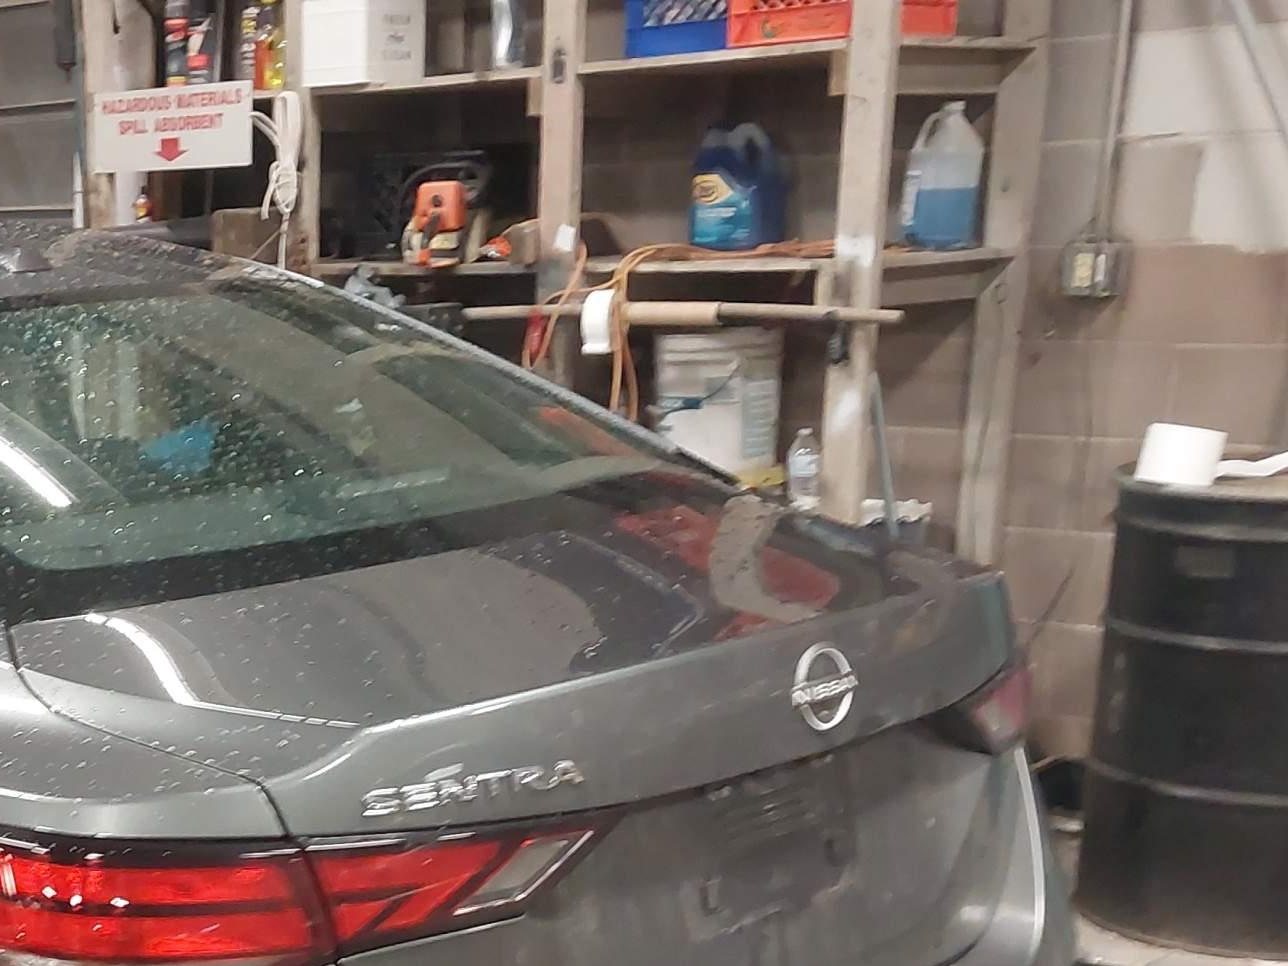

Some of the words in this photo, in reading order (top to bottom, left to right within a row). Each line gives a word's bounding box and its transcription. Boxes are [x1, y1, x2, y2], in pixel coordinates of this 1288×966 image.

[102, 95, 172, 115] HAZARDOUS
[176, 88, 243, 109] MATERIALS
[118, 118, 149, 135] SPILL
[153, 113, 224, 133] ABSORBENT
[361, 759, 585, 817] SENTRA
